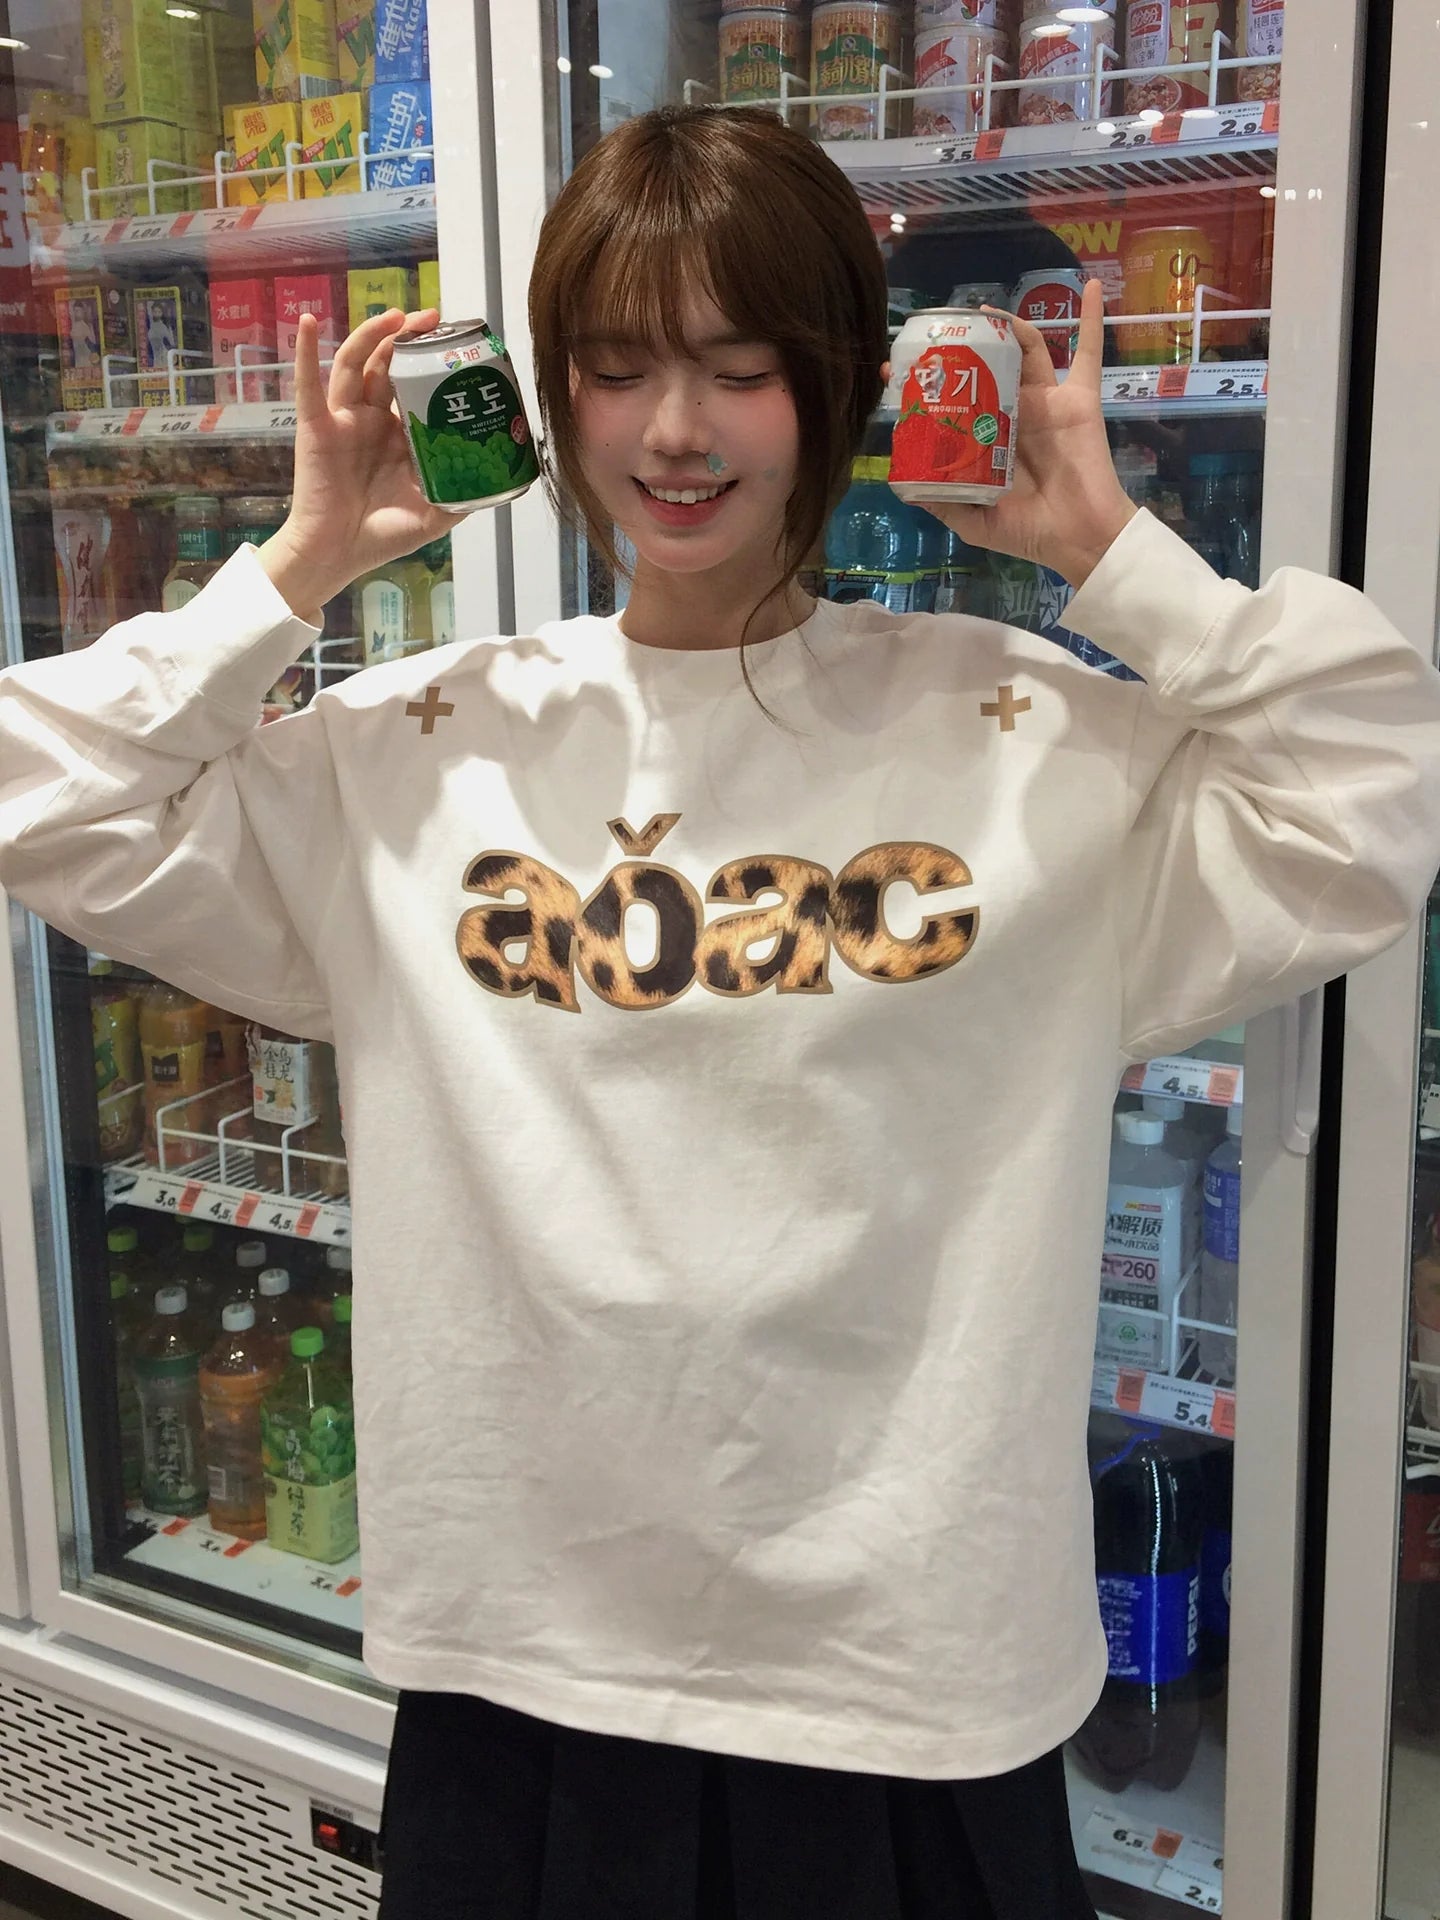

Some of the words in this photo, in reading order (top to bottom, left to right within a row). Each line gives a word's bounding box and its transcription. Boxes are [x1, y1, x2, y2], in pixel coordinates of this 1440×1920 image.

[442, 382, 506, 423] 포도
[1123, 1260, 1156, 1281] 260
[1187, 1576, 1199, 1656] PEPSI
